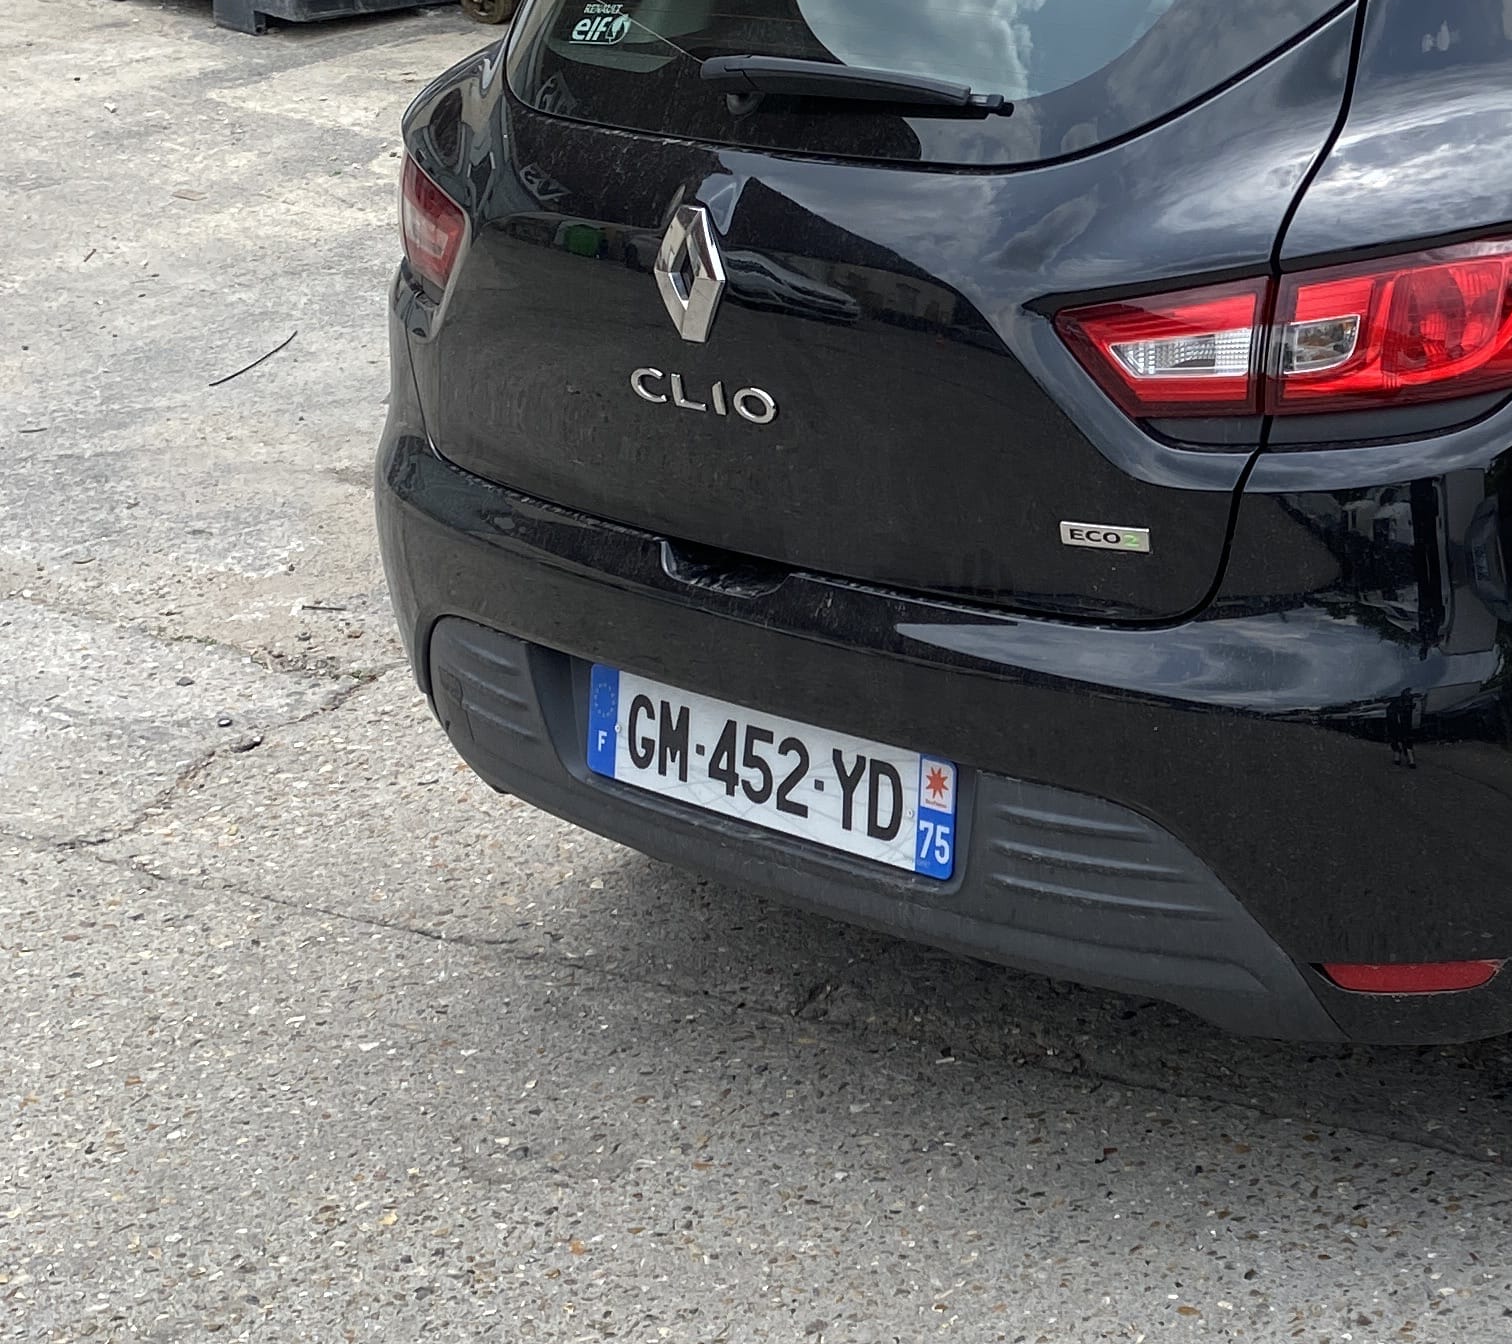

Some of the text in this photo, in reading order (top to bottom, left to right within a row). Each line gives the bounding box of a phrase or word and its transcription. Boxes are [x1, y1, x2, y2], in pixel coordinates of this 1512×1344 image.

[572, 16, 613, 41] elf
[630, 367, 777, 425] CLIO
[1069, 528, 1140, 548] ECO2
[597, 730, 608, 752] F
[918, 819, 951, 865] 75
